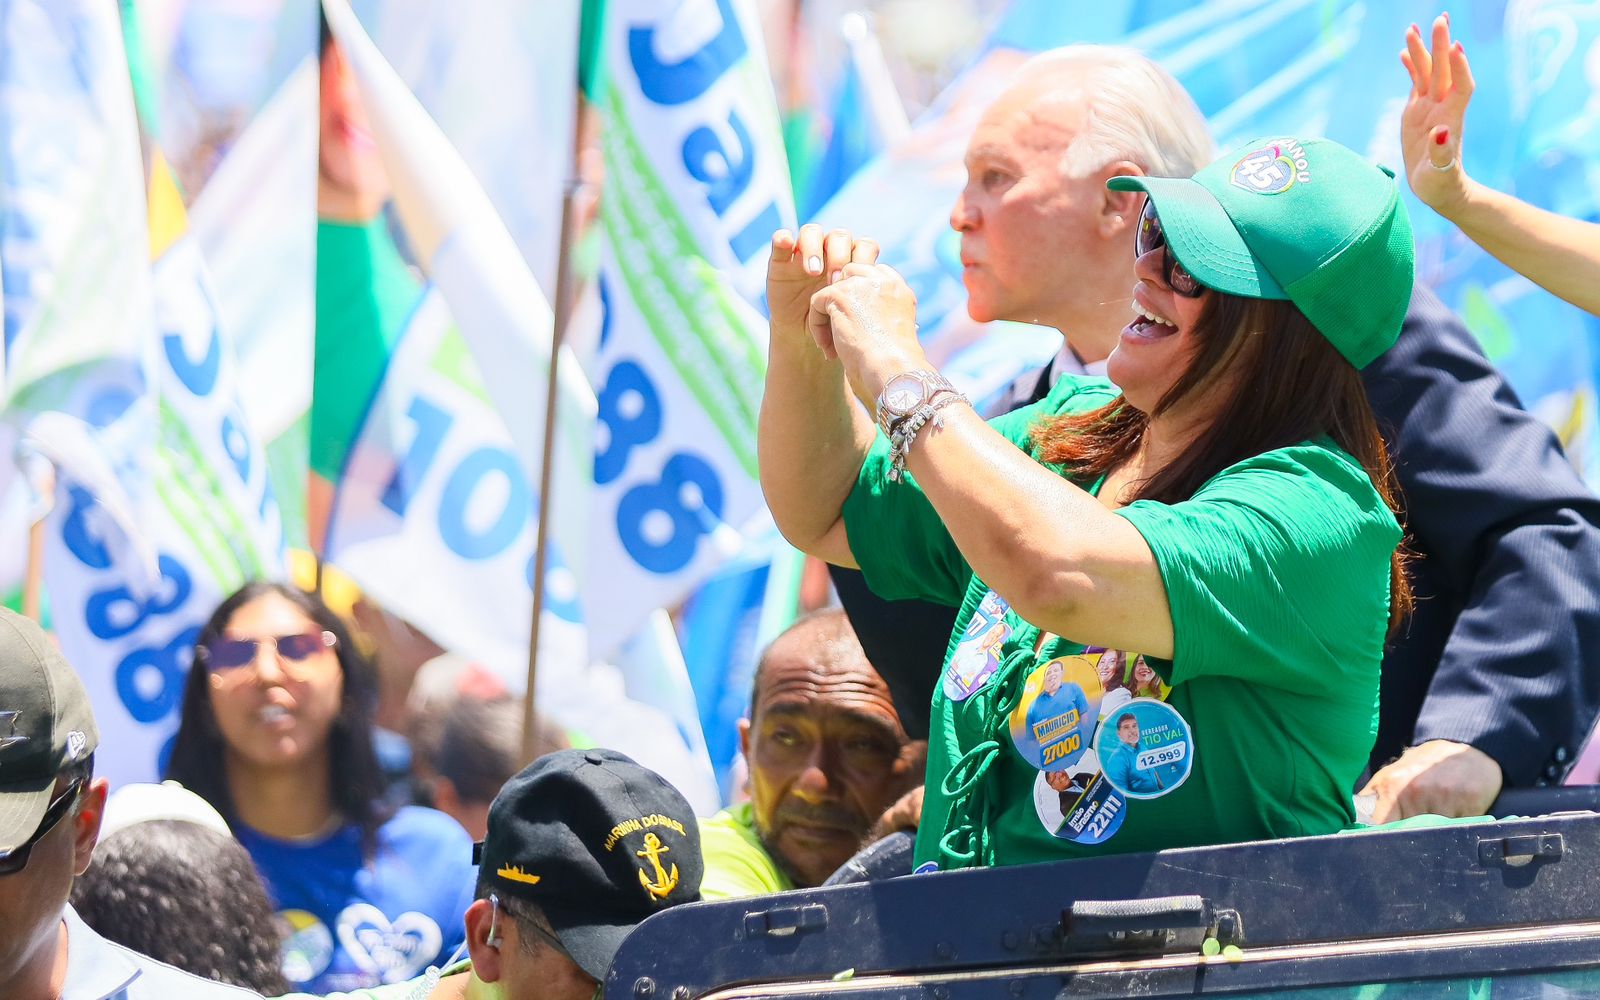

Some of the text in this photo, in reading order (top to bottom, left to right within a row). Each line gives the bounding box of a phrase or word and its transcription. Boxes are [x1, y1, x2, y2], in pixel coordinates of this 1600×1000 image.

[1239, 154, 1284, 189] 45
[1037, 711, 1075, 737] MAURICIO
[1142, 728, 1184, 746] TIO VAL
[1043, 733, 1081, 766] 27000
[1140, 749, 1181, 766] 12.999
[604, 818, 643, 852] MARINHA
[641, 813, 659, 828] DO
[1073, 800, 1099, 833] Erasmo
[1087, 794, 1122, 838] 22111
